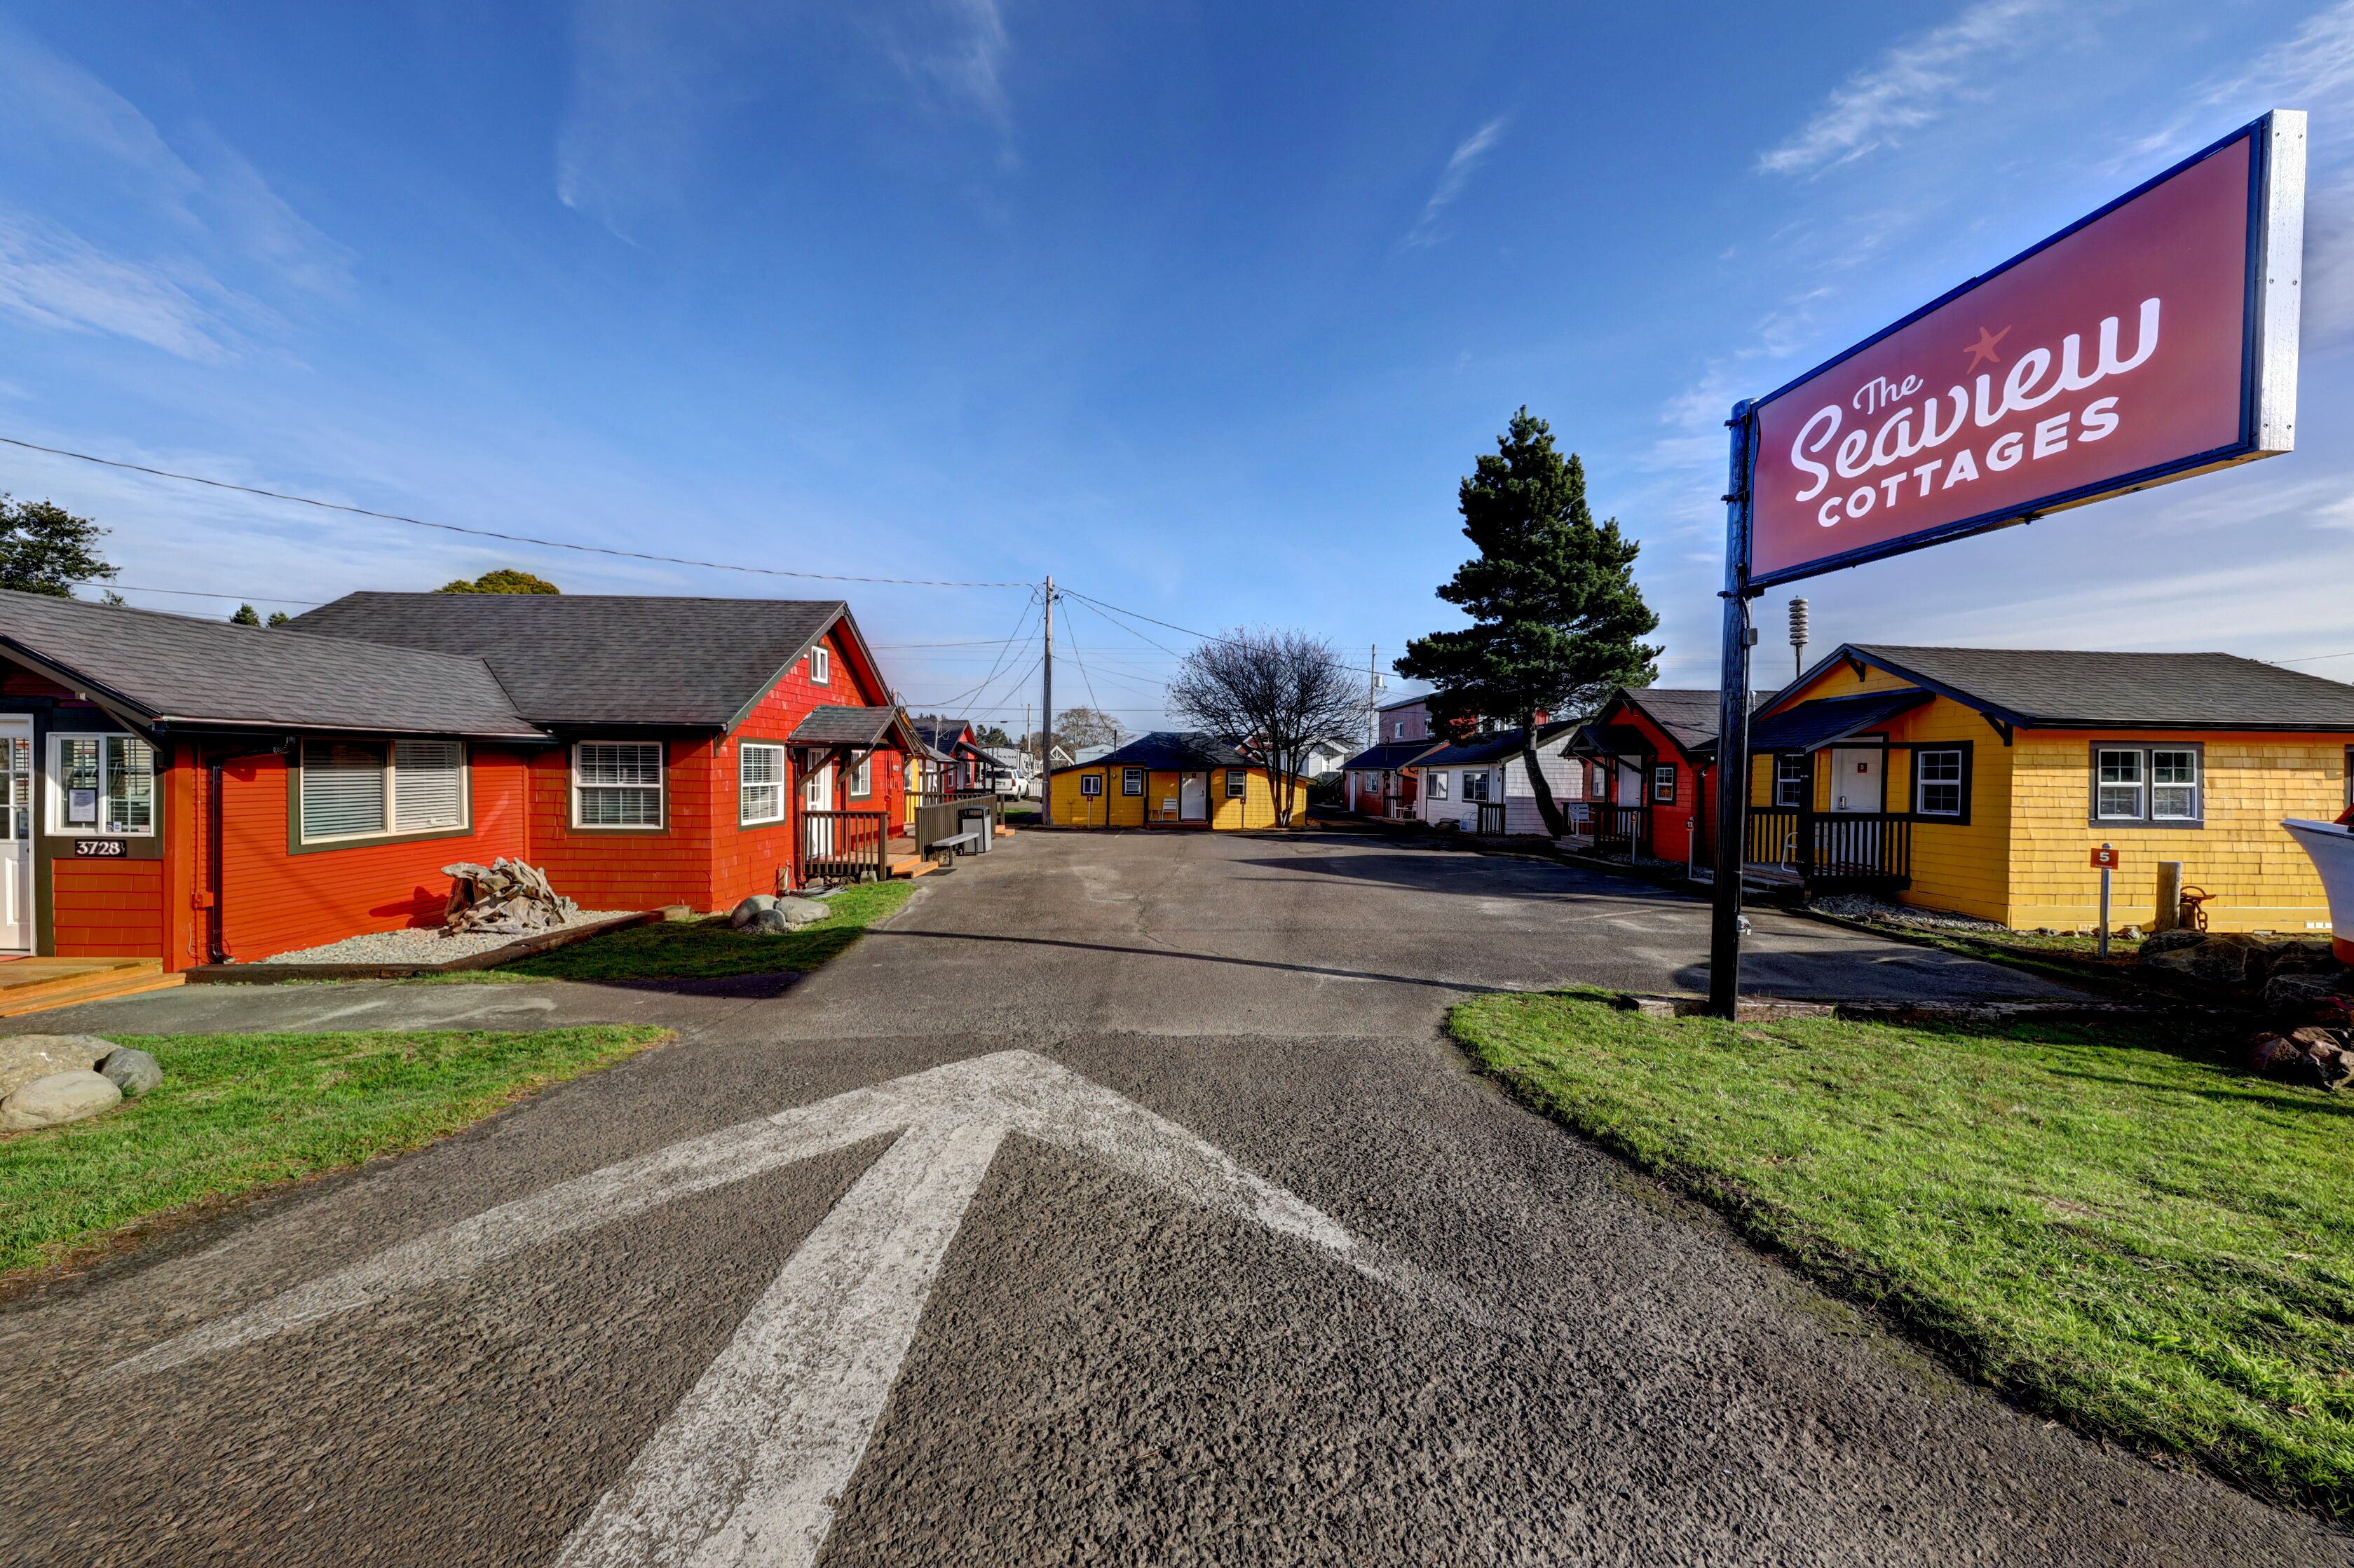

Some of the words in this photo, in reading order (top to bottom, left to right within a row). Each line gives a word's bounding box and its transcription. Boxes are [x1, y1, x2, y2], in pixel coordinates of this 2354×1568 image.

[1790, 297, 2161, 502] Seaview
[1853, 374, 1924, 415] The
[1817, 397, 2119, 527] COTTAGES
[76, 841, 121, 855] 3728
[2099, 852, 2110, 862] 5
